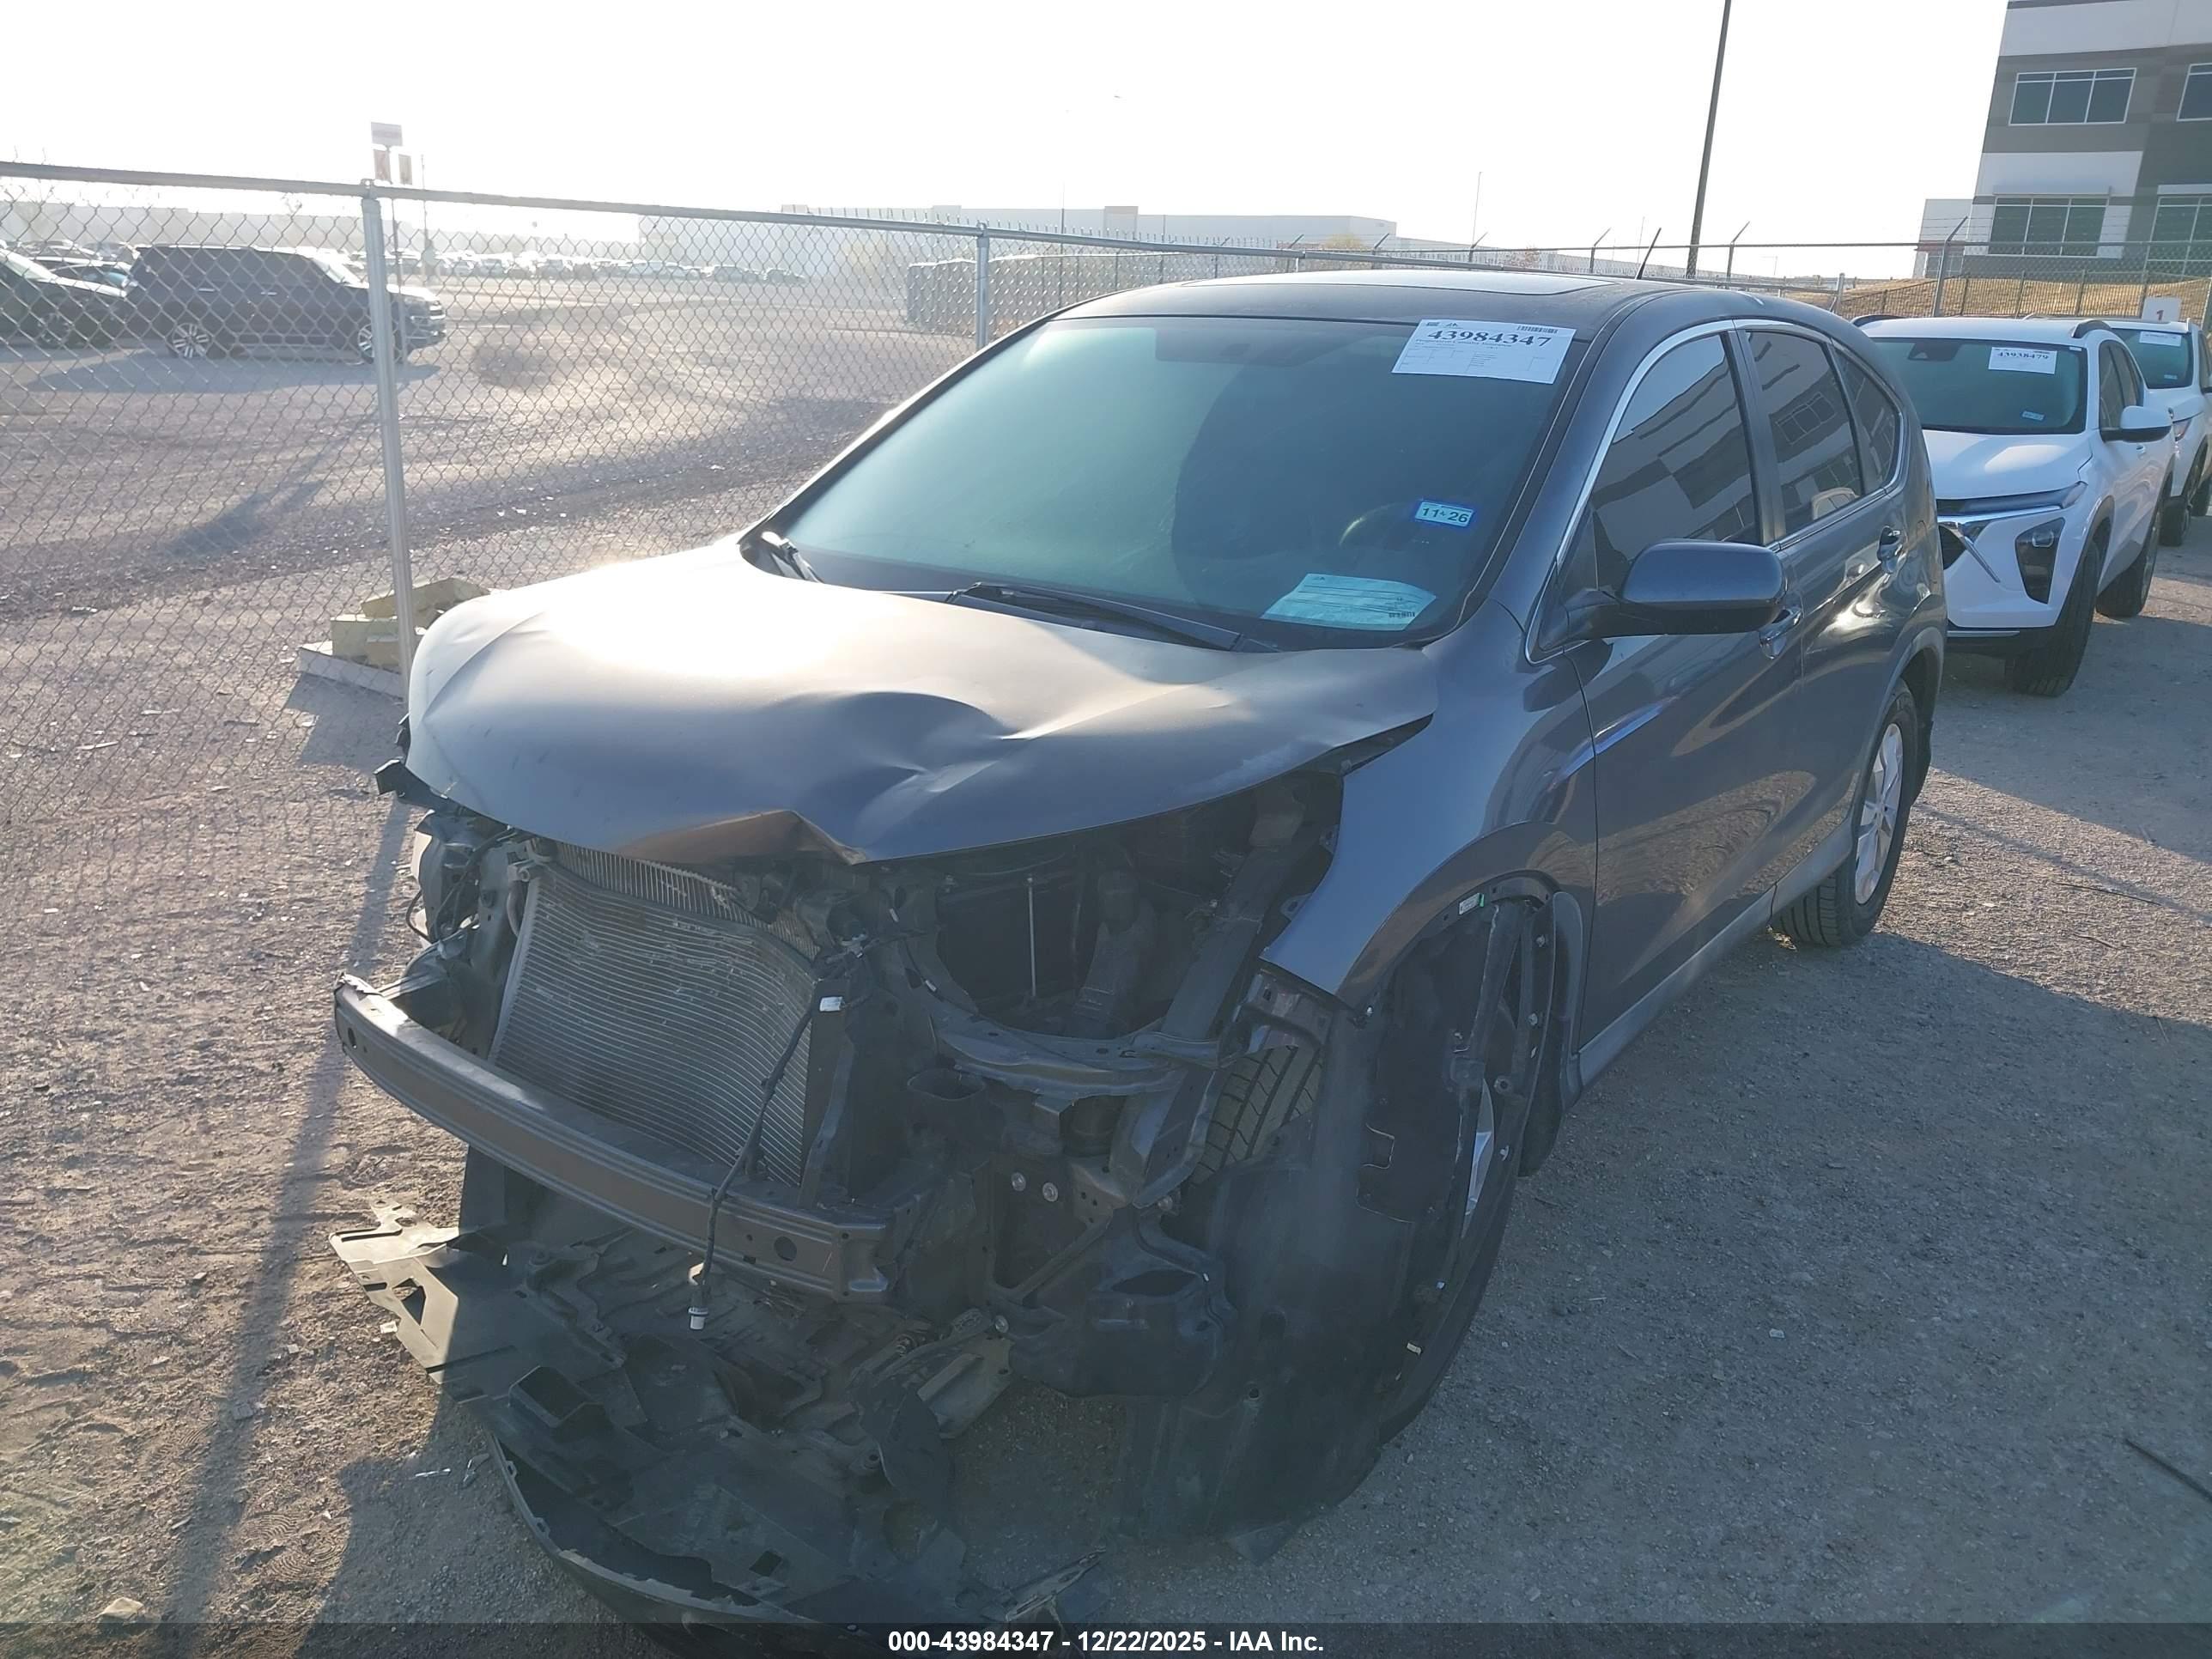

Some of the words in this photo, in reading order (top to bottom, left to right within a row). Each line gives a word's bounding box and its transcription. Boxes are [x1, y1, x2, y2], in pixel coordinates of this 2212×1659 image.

[1427, 330, 1553, 348] 43984347
[1422, 507, 1440, 518] 11
[1447, 512, 1469, 523] 26
